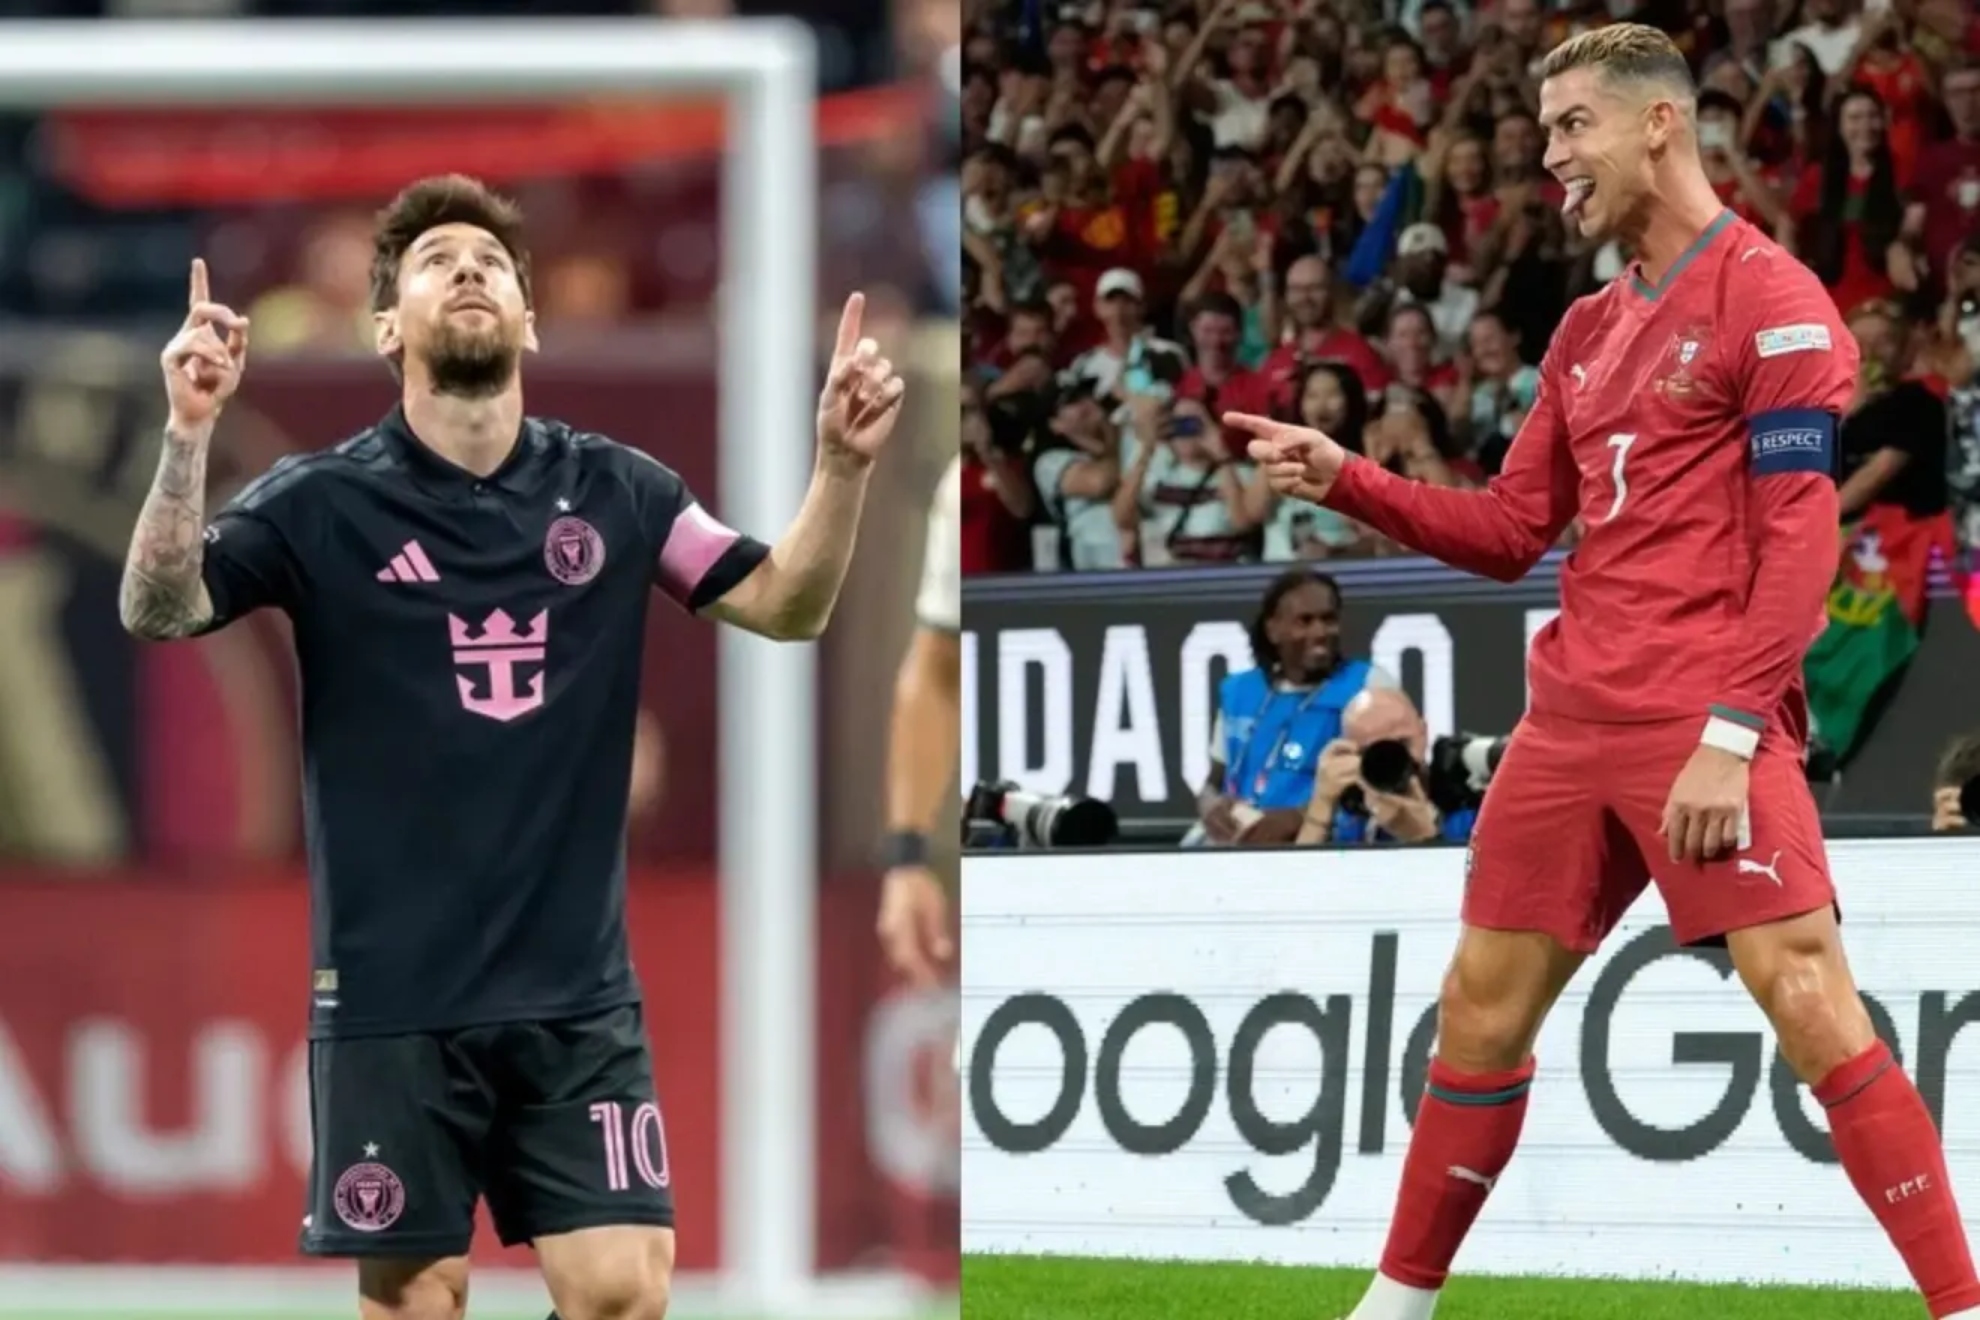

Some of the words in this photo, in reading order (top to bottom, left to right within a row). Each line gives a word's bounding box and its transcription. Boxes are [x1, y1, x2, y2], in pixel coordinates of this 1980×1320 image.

[1602, 432, 1638, 524] 7
[1762, 432, 1823, 452] RESPECT
[969, 930, 1438, 1226] oogl
[589, 1102, 670, 1190] 10
